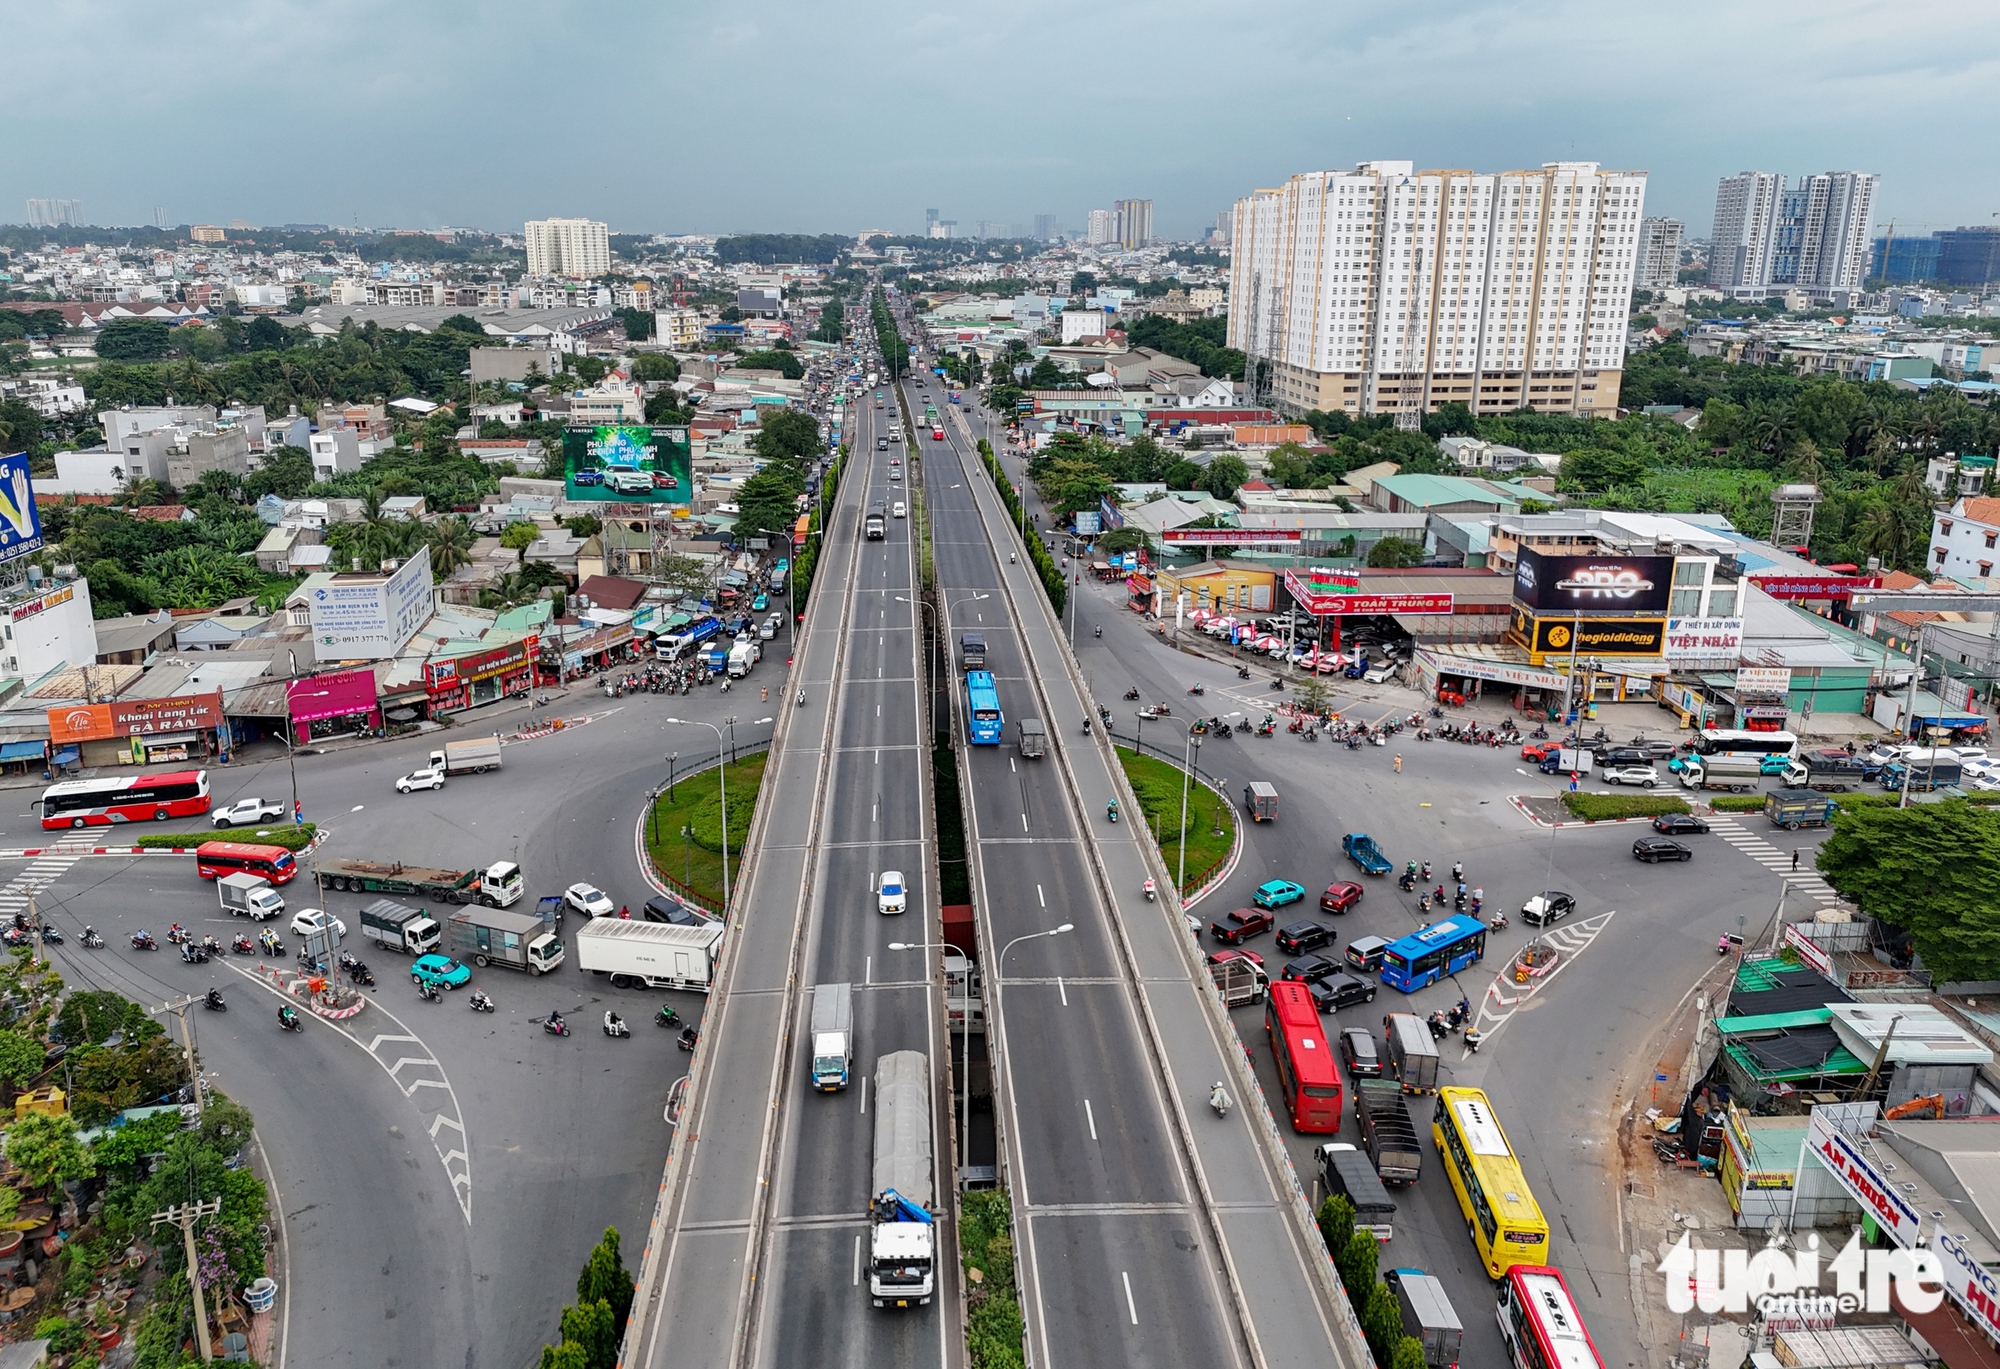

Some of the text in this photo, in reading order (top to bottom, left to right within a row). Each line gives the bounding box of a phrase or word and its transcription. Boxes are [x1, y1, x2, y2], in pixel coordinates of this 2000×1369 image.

[1572, 572, 1639, 598] PRO
[1354, 599, 1388, 608] TOÀN
[1685, 620, 1740, 630] THIẾT BỊ XÂY DỰNG
[1576, 633, 1655, 645] hegioididong
[1668, 633, 1738, 650] VIỆT NHẬT
[1505, 670, 1564, 686] VIỆT NHẬT
[1768, 669, 1789, 677] NHẬT
[118, 712, 154, 723] Khoai
[158, 708, 186, 720] Lang
[130, 716, 198, 734] GÀ RÁN
[1822, 1141, 1846, 1170] AN
[1847, 1164, 1901, 1228] NHIÊN
[1941, 1235, 1998, 1297] CÔNG
